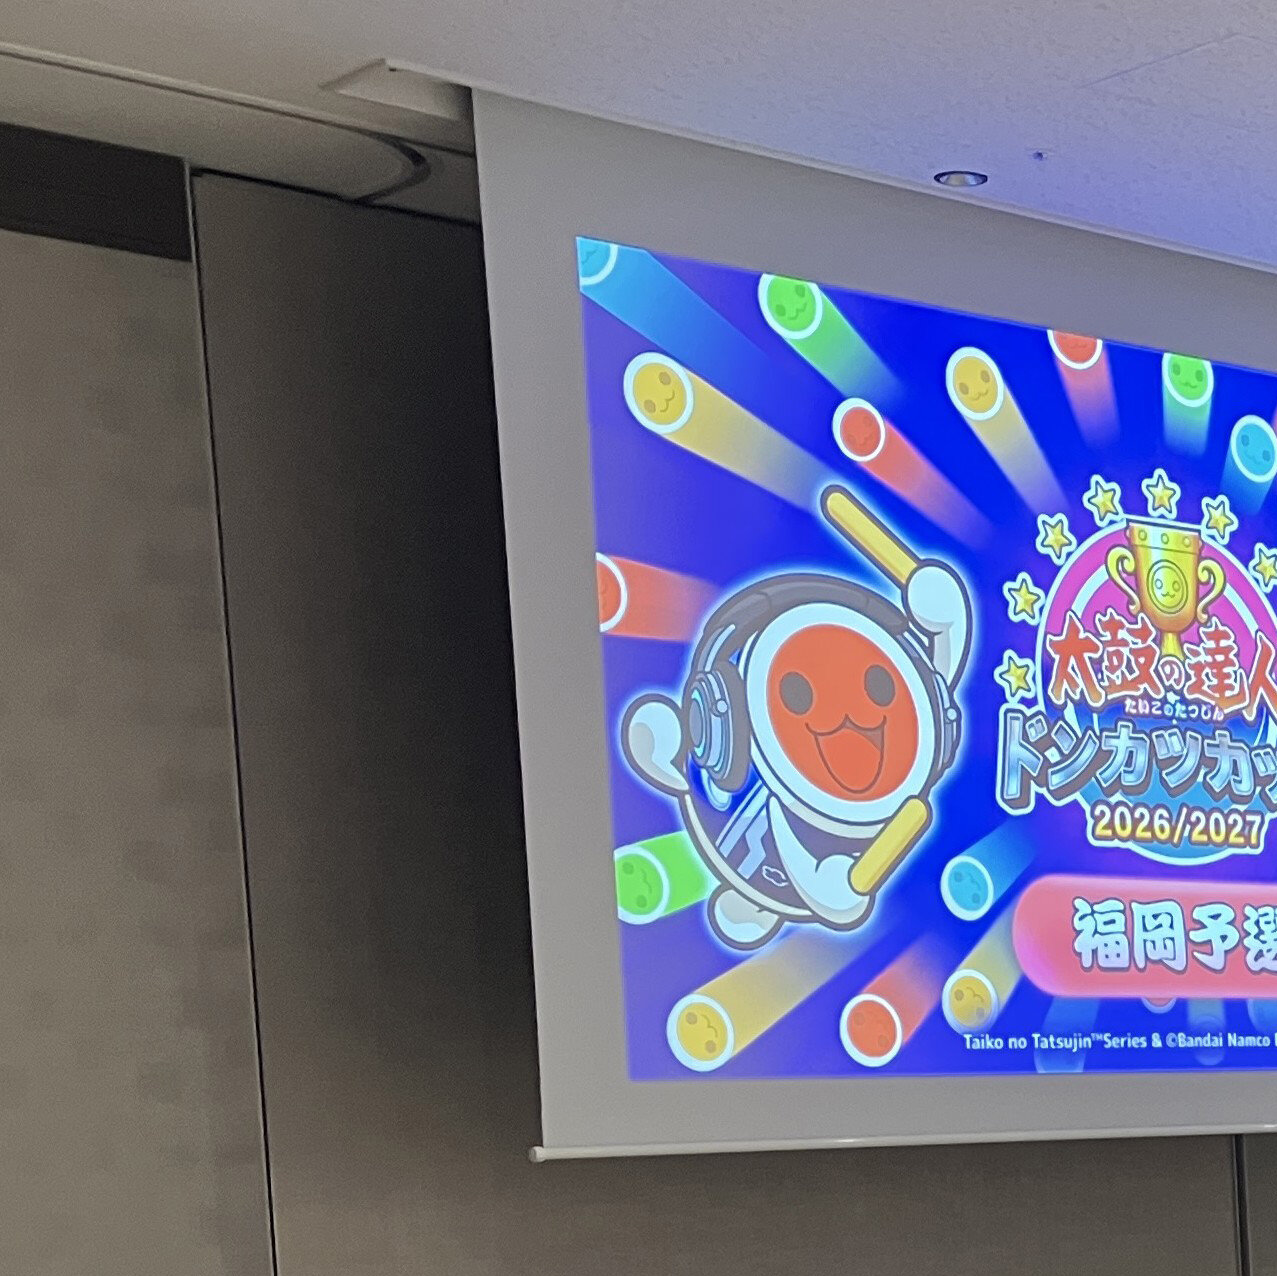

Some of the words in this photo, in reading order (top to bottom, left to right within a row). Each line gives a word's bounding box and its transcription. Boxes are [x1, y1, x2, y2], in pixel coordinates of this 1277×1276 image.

[1093, 804, 1264, 847] 2026/2027
[963, 1033, 1004, 1050] Taiko
[1008, 1036, 1028, 1050] no
[1151, 1032, 1163, 1048] &
[1227, 1032, 1271, 1048] Namco
